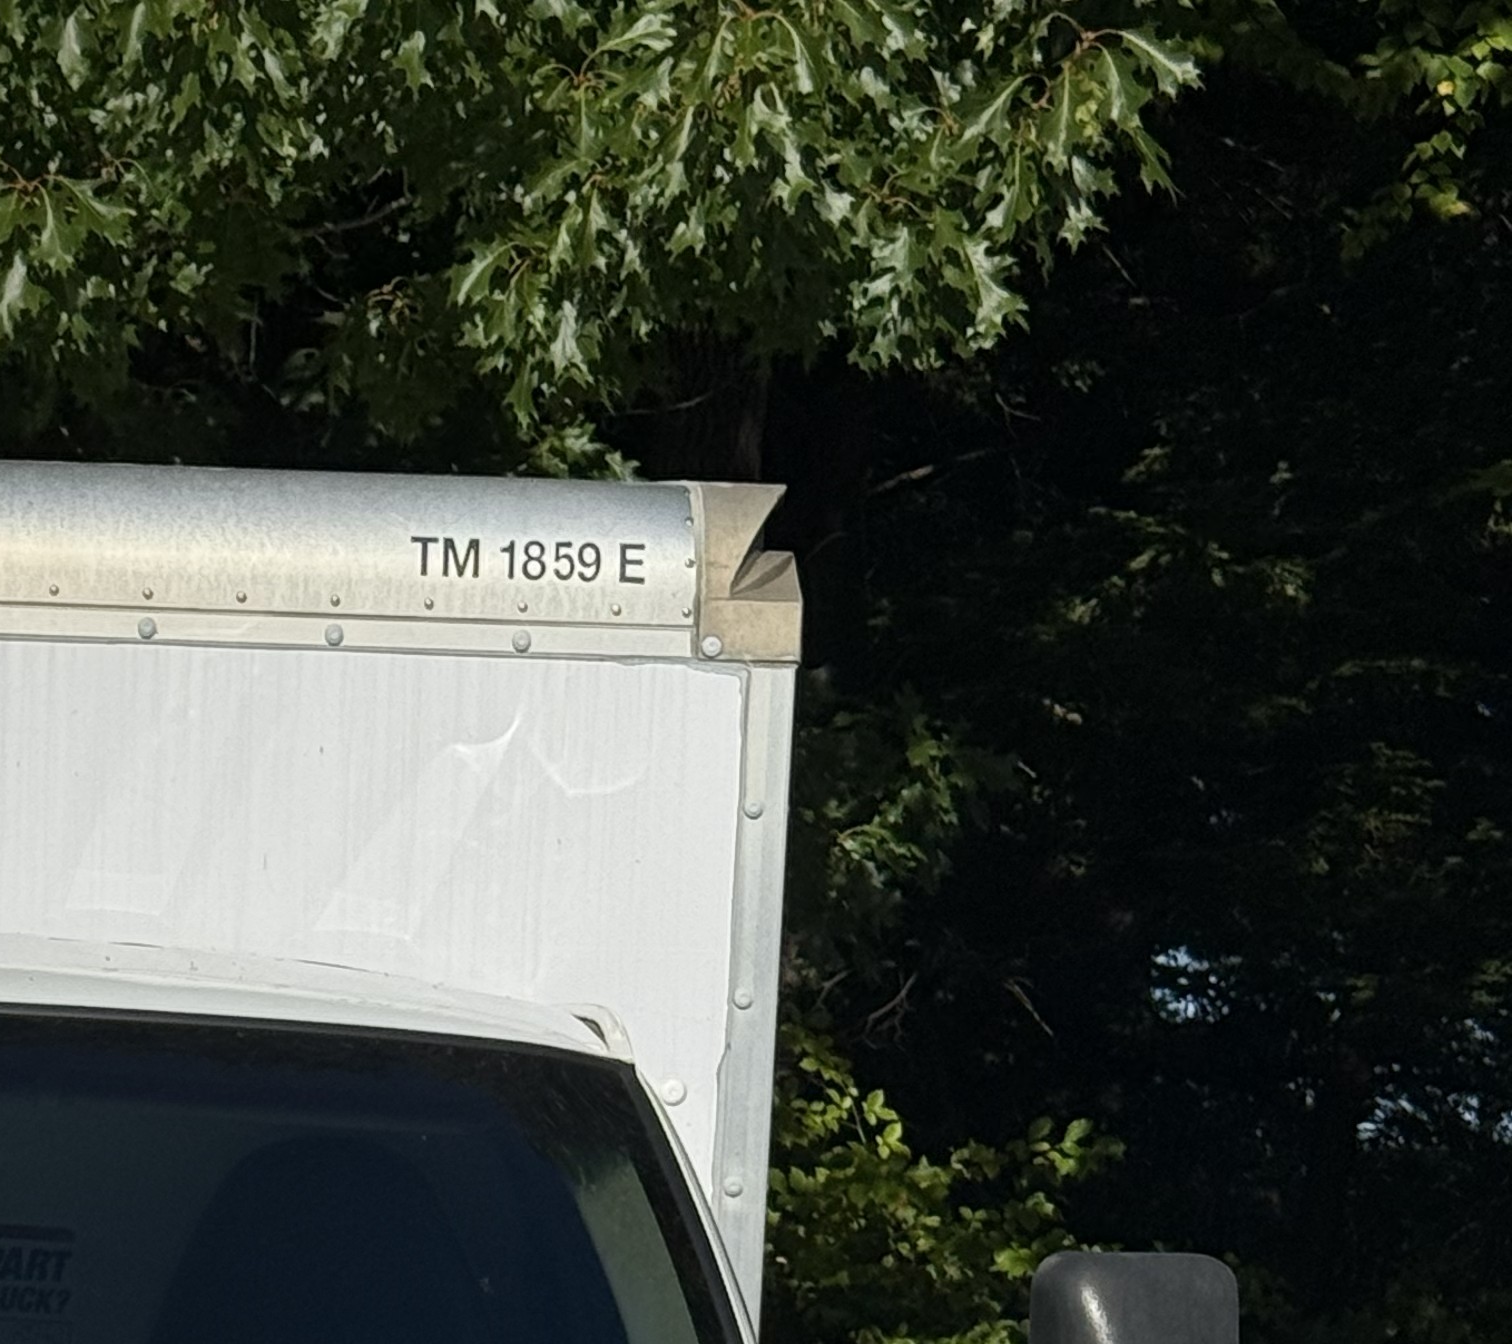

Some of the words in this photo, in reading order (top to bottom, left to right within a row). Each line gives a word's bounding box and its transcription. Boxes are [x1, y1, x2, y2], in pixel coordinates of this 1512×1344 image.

[410, 536, 481, 578] TM
[500, 540, 602, 582] 1859
[619, 543, 646, 585] E
